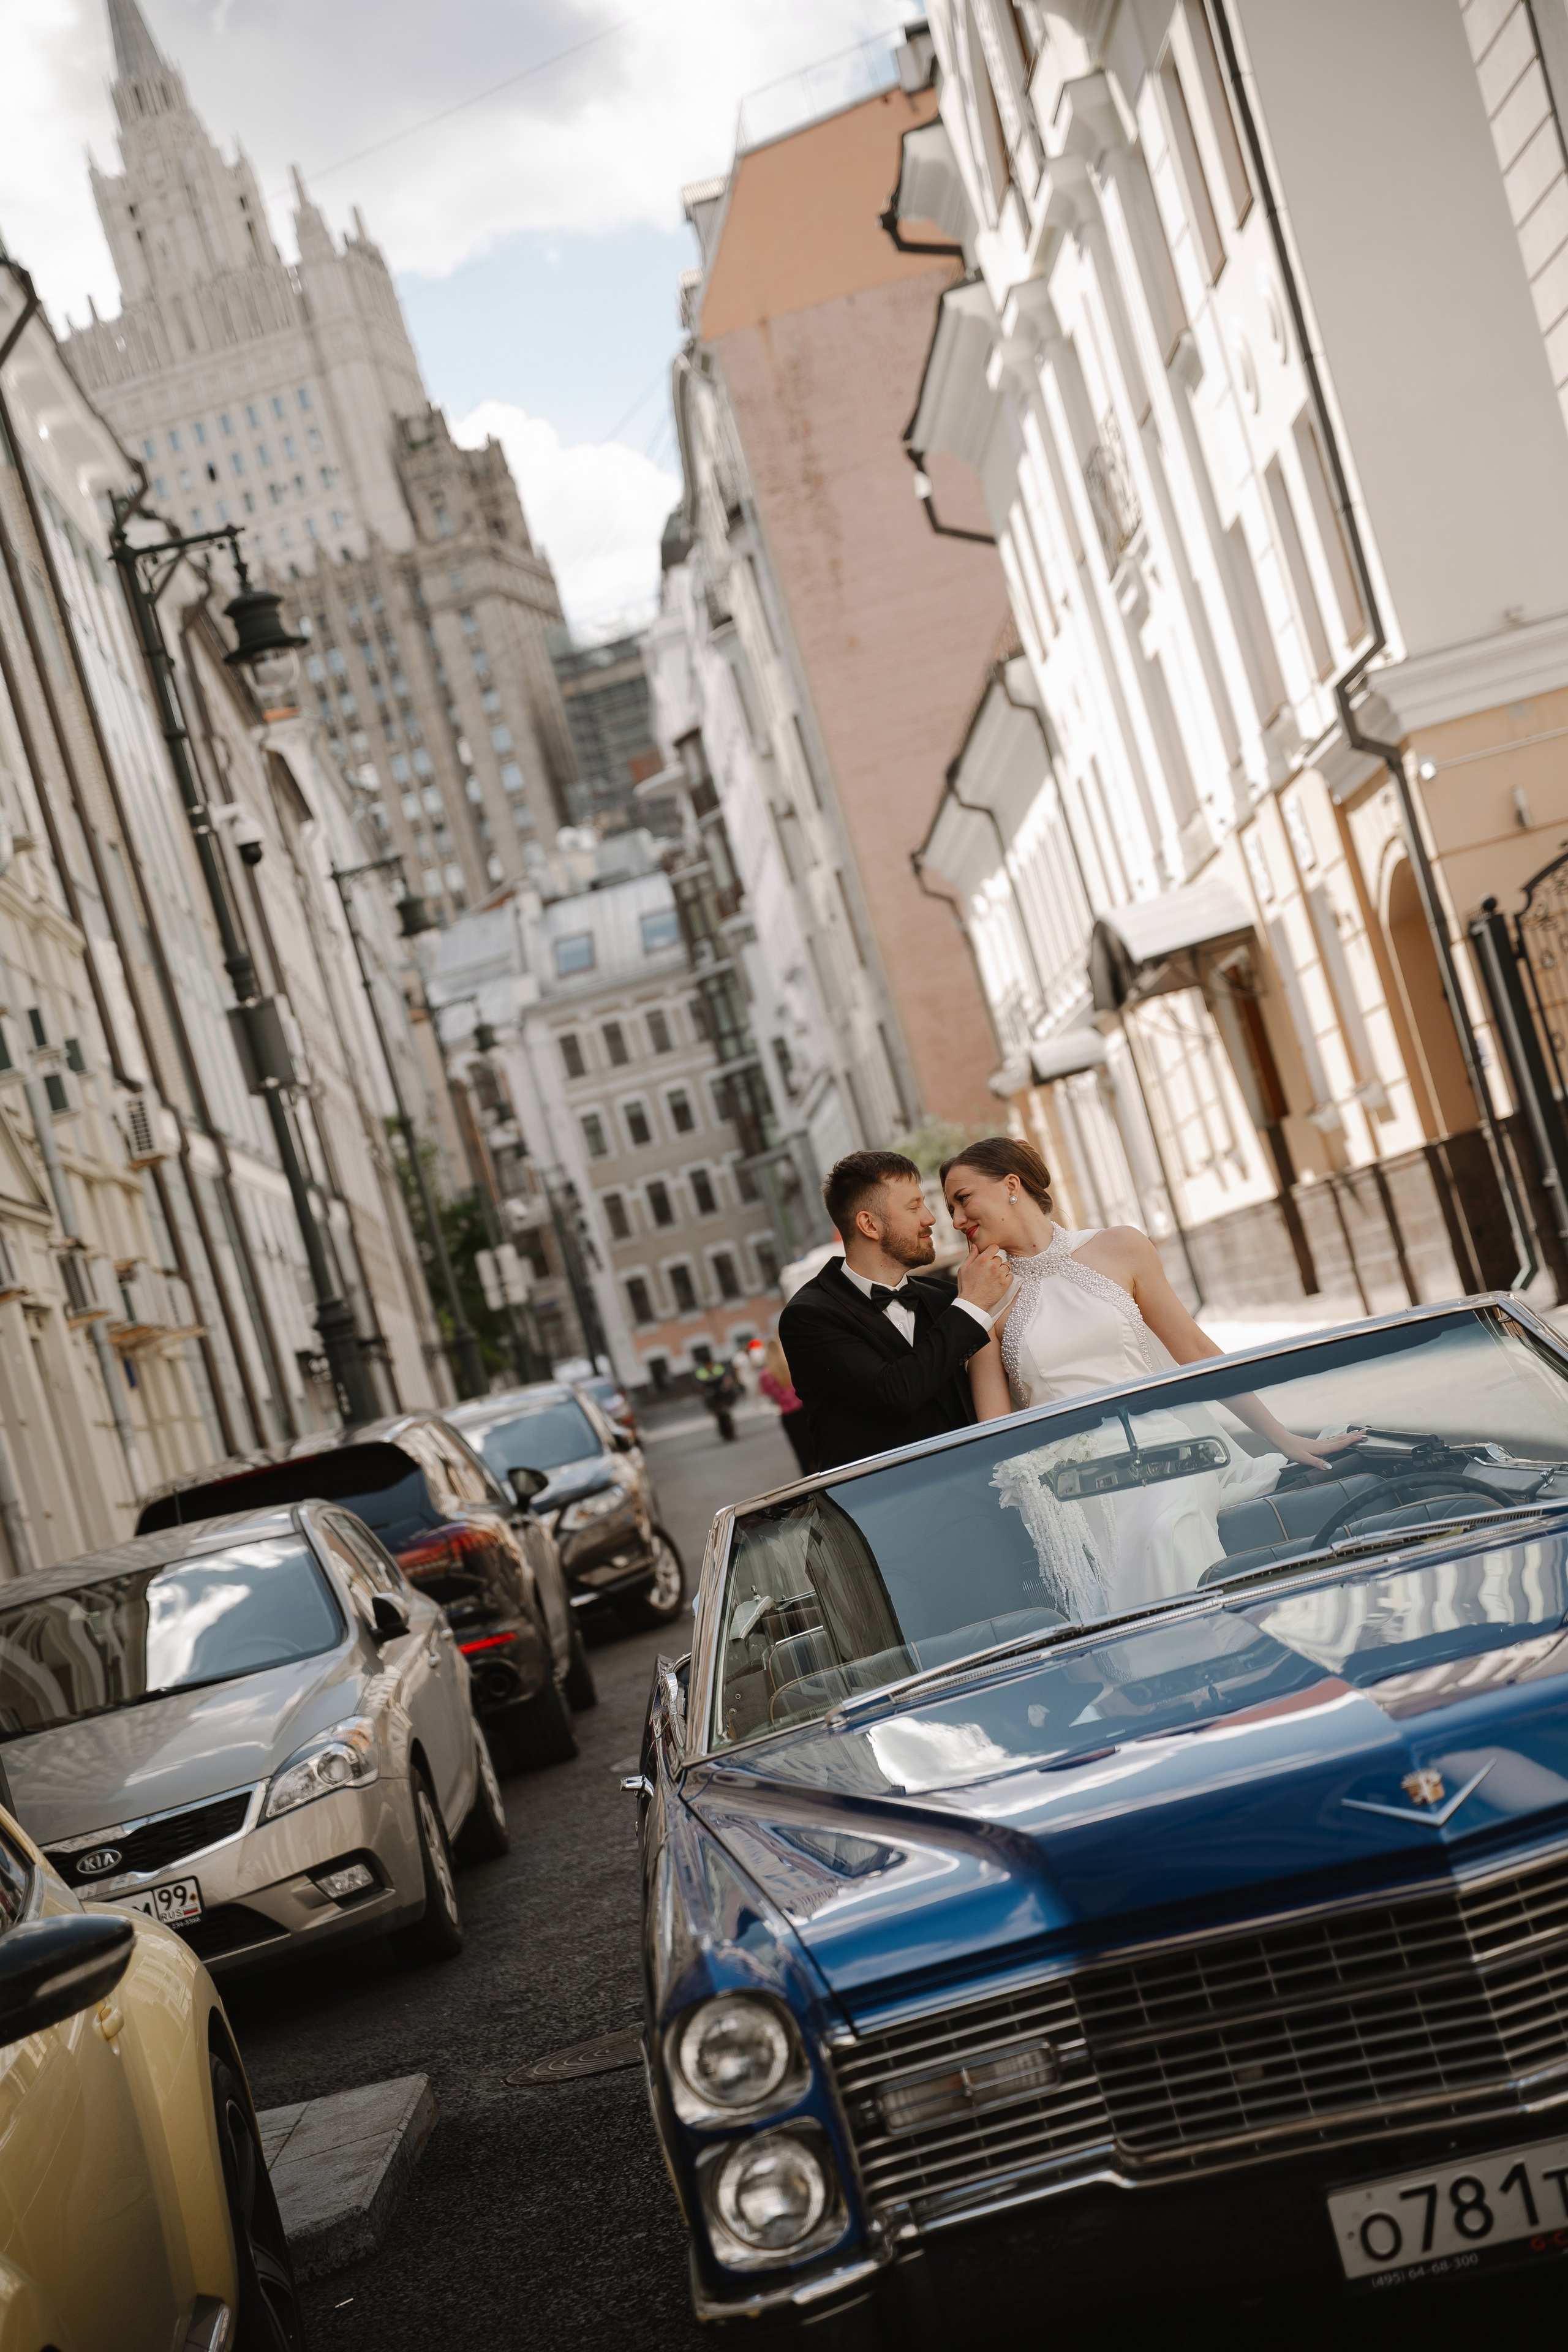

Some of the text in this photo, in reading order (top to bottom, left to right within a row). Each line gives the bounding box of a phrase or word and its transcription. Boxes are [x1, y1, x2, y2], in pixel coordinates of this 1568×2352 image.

[83, 1852, 116, 1872] KIA
[158, 1885, 187, 1911] 99
[159, 1909, 183, 1922] RUS
[1371, 2270, 1405, 2289] (495)
